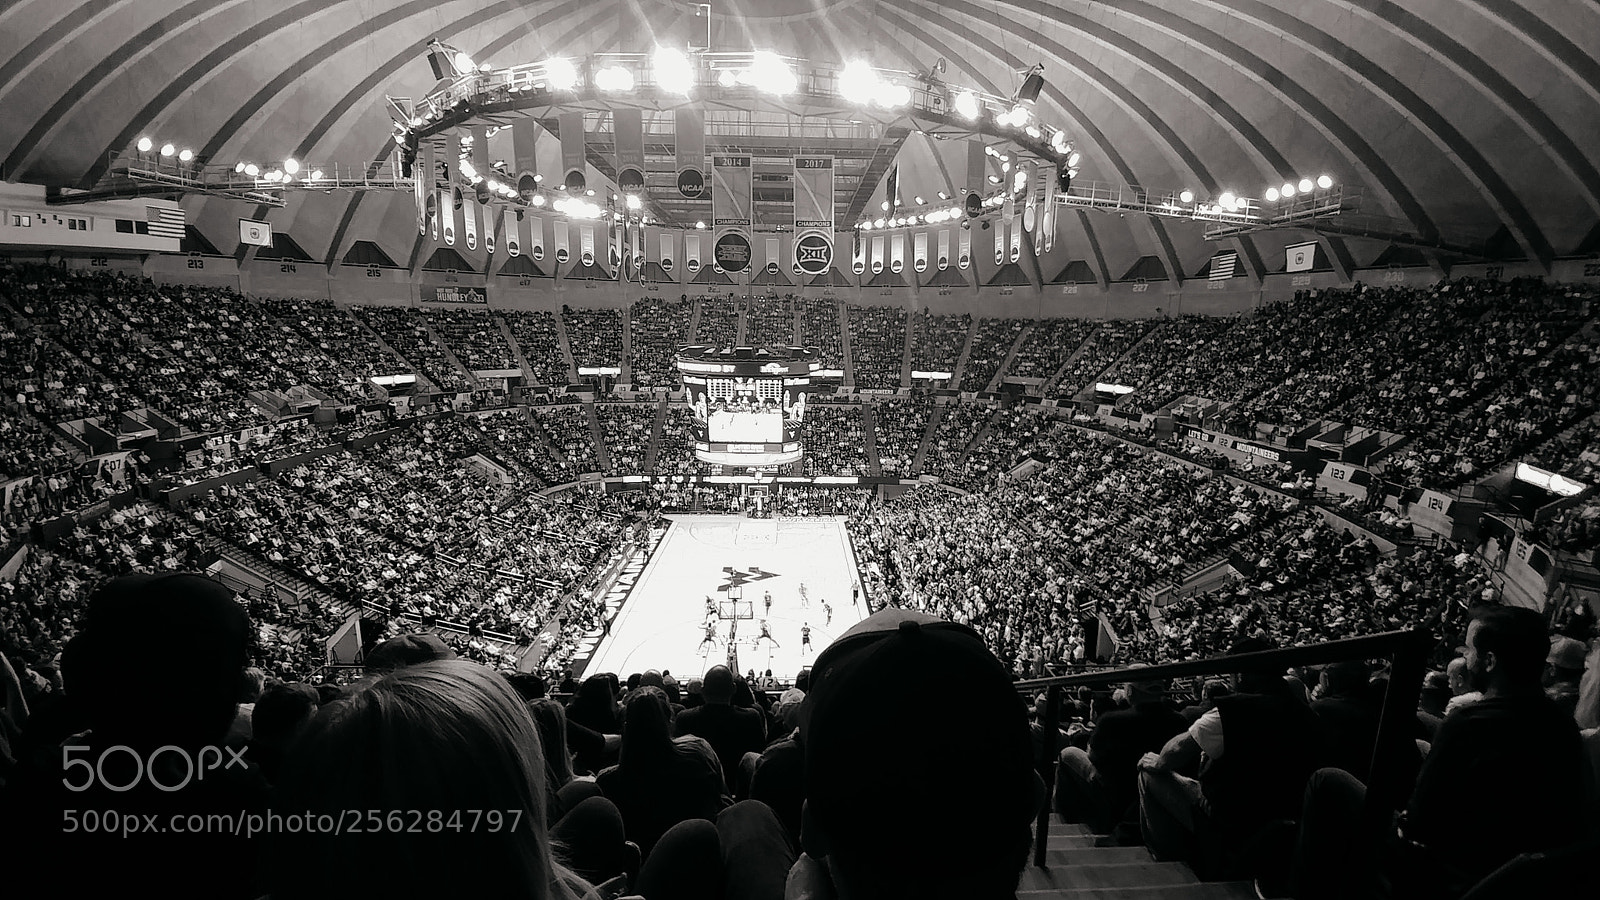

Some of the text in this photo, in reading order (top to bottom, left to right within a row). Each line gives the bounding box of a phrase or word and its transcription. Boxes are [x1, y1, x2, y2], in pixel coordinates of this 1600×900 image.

[722, 158, 743, 166] 2014
[804, 160, 824, 168] 2017
[681, 184, 703, 192] NCAA
[91, 257, 107, 266] 212
[187, 259, 204, 269] 213
[280, 264, 296, 273] 214
[366, 269, 381, 277] 215
[1132, 284, 1149, 292] 227
[436, 293, 468, 302] HUNDLEY
[1188, 429, 1209, 442] LET'S GO
[1219, 437, 1229, 447] 122
[1236, 442, 1280, 461] MOUNTAINEERS
[110, 459, 121, 471] 07
[1330, 467, 1345, 480] 123
[1427, 496, 1444, 512] 124
